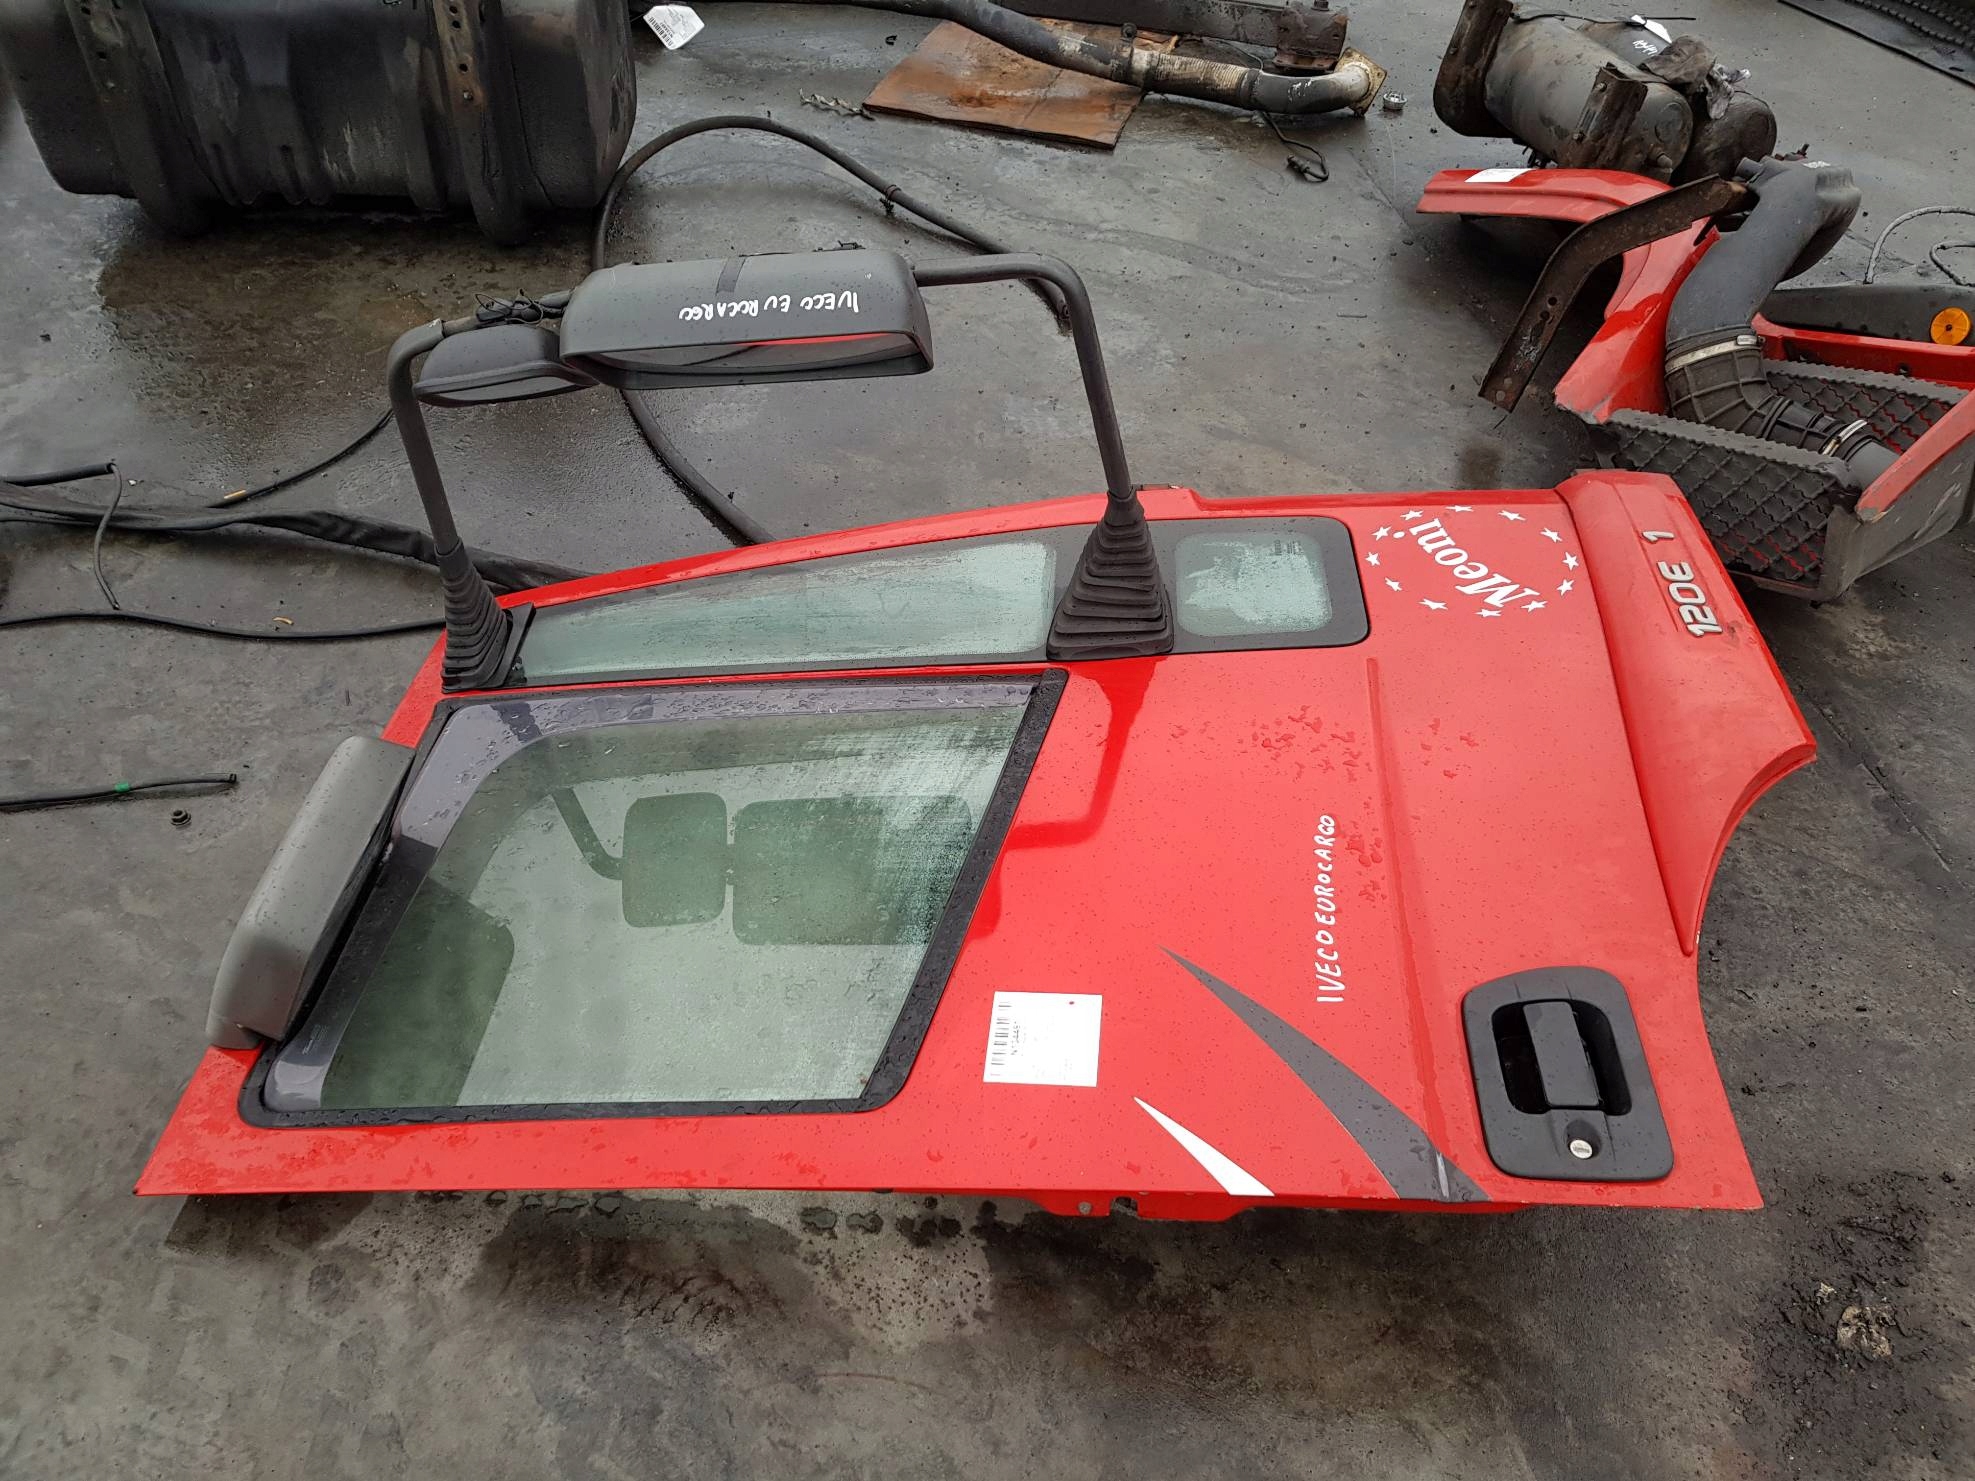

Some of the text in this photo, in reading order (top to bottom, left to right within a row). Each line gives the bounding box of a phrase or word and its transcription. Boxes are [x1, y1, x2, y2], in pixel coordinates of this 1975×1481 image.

[799, 290, 860, 315] IVECO
[1392, 517, 1541, 608] Meoni
[1657, 561, 1723, 636] 120E
[1313, 814, 1346, 1003] IVECO EUROCARGO
